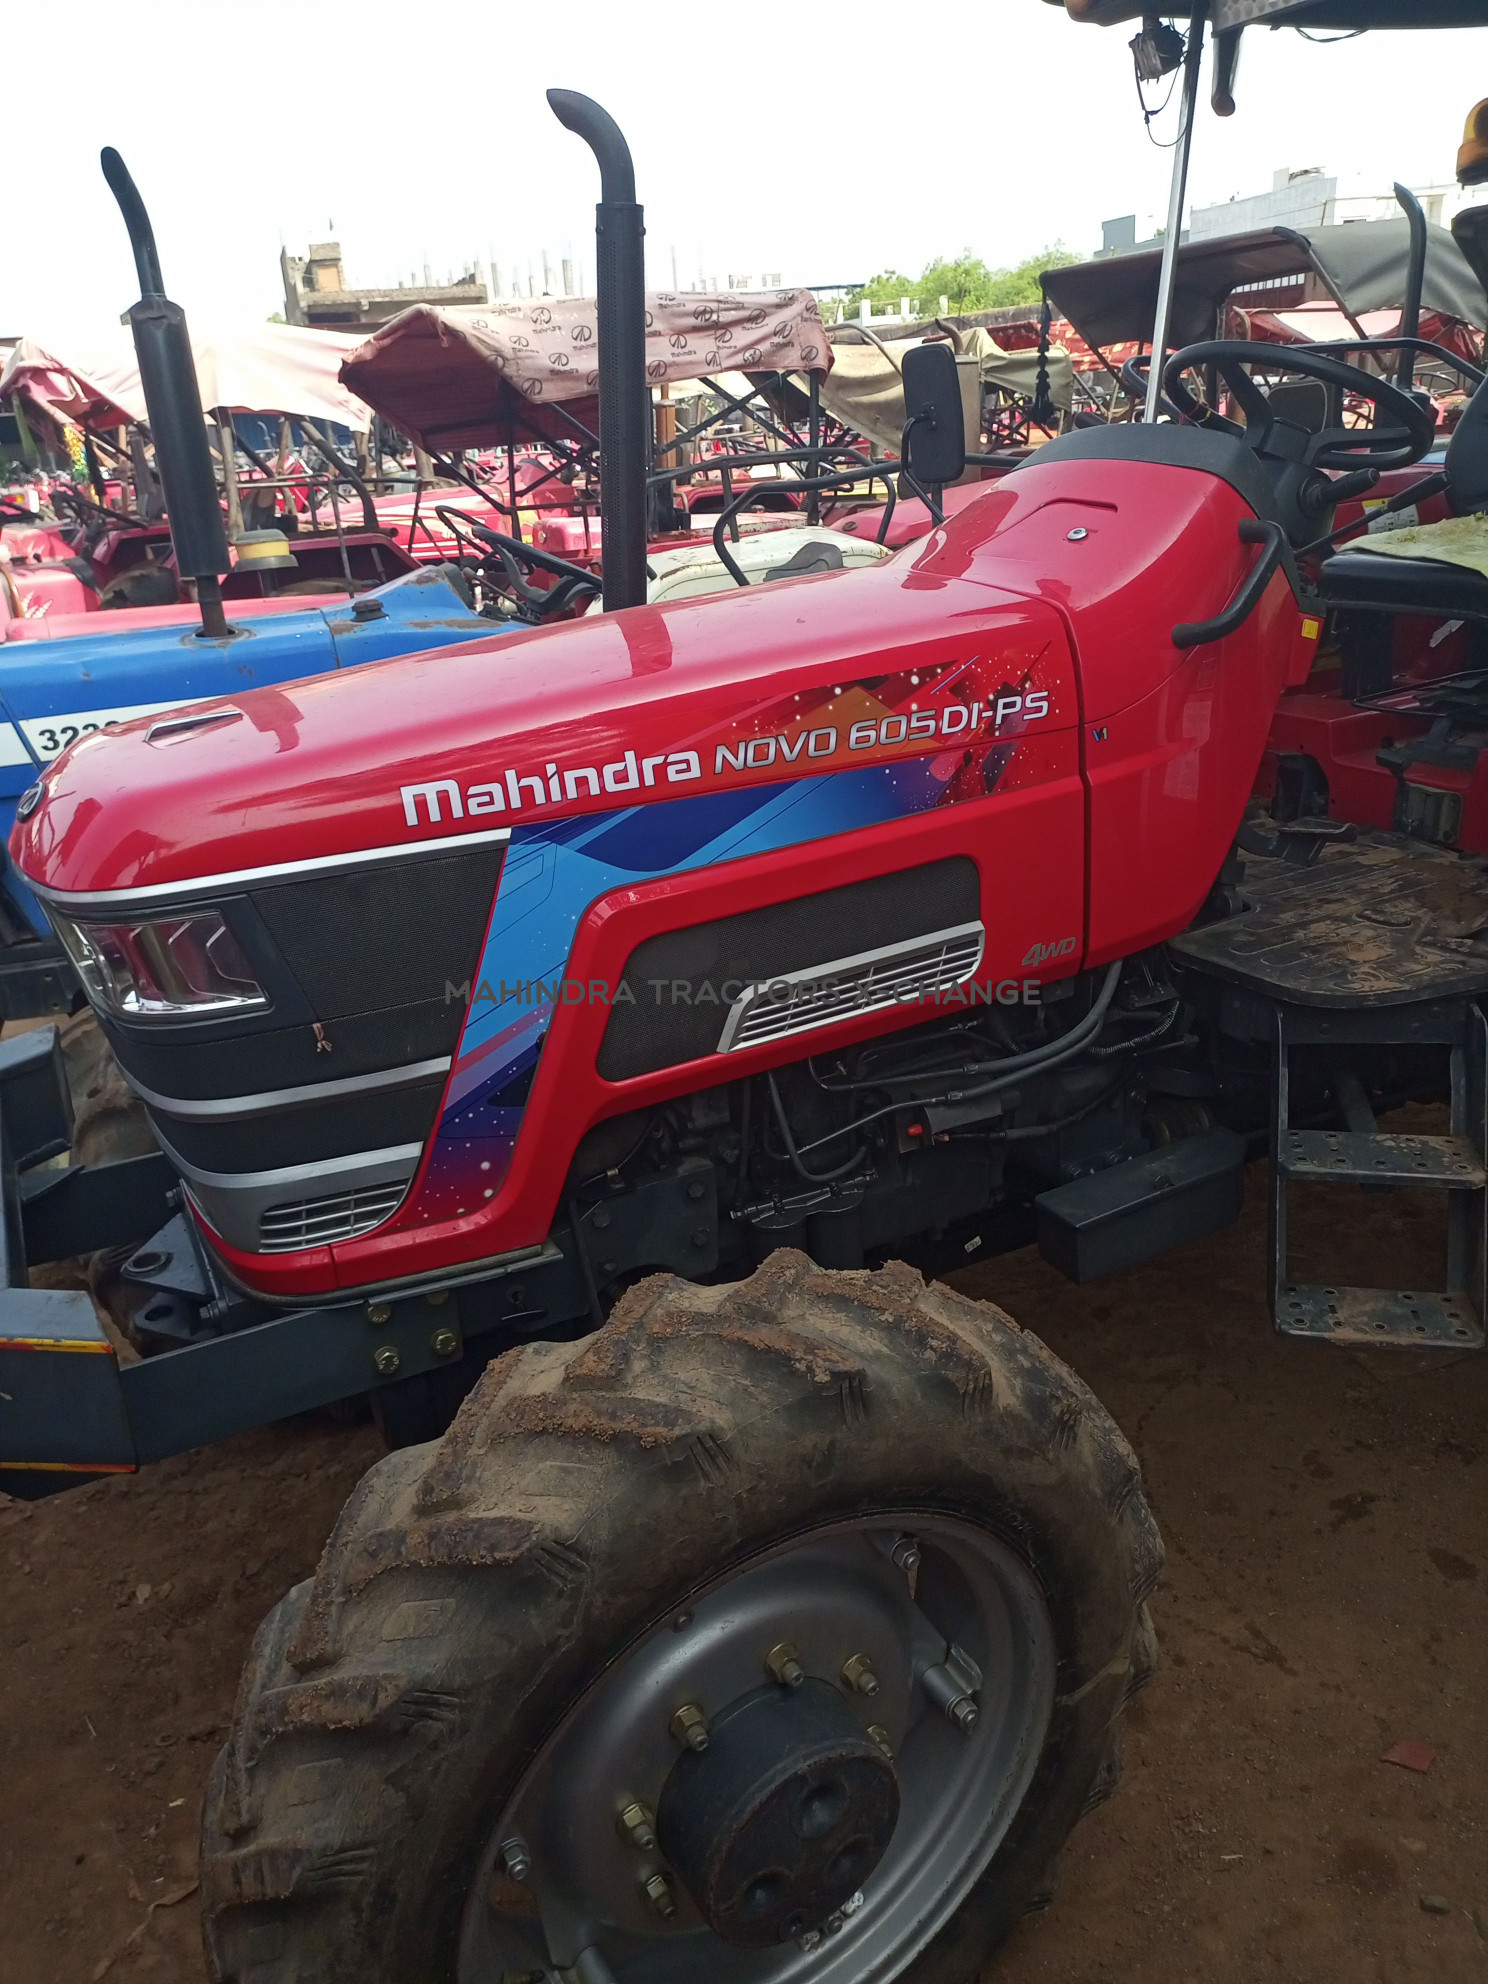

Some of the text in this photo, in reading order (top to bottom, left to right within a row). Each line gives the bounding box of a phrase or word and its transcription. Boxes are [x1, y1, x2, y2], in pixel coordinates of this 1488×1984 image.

[38, 720, 120, 752] 32
[400, 750, 702, 827] Mahindra
[714, 726, 838, 775] NOVO
[1021, 936, 1077, 967] 4WD
